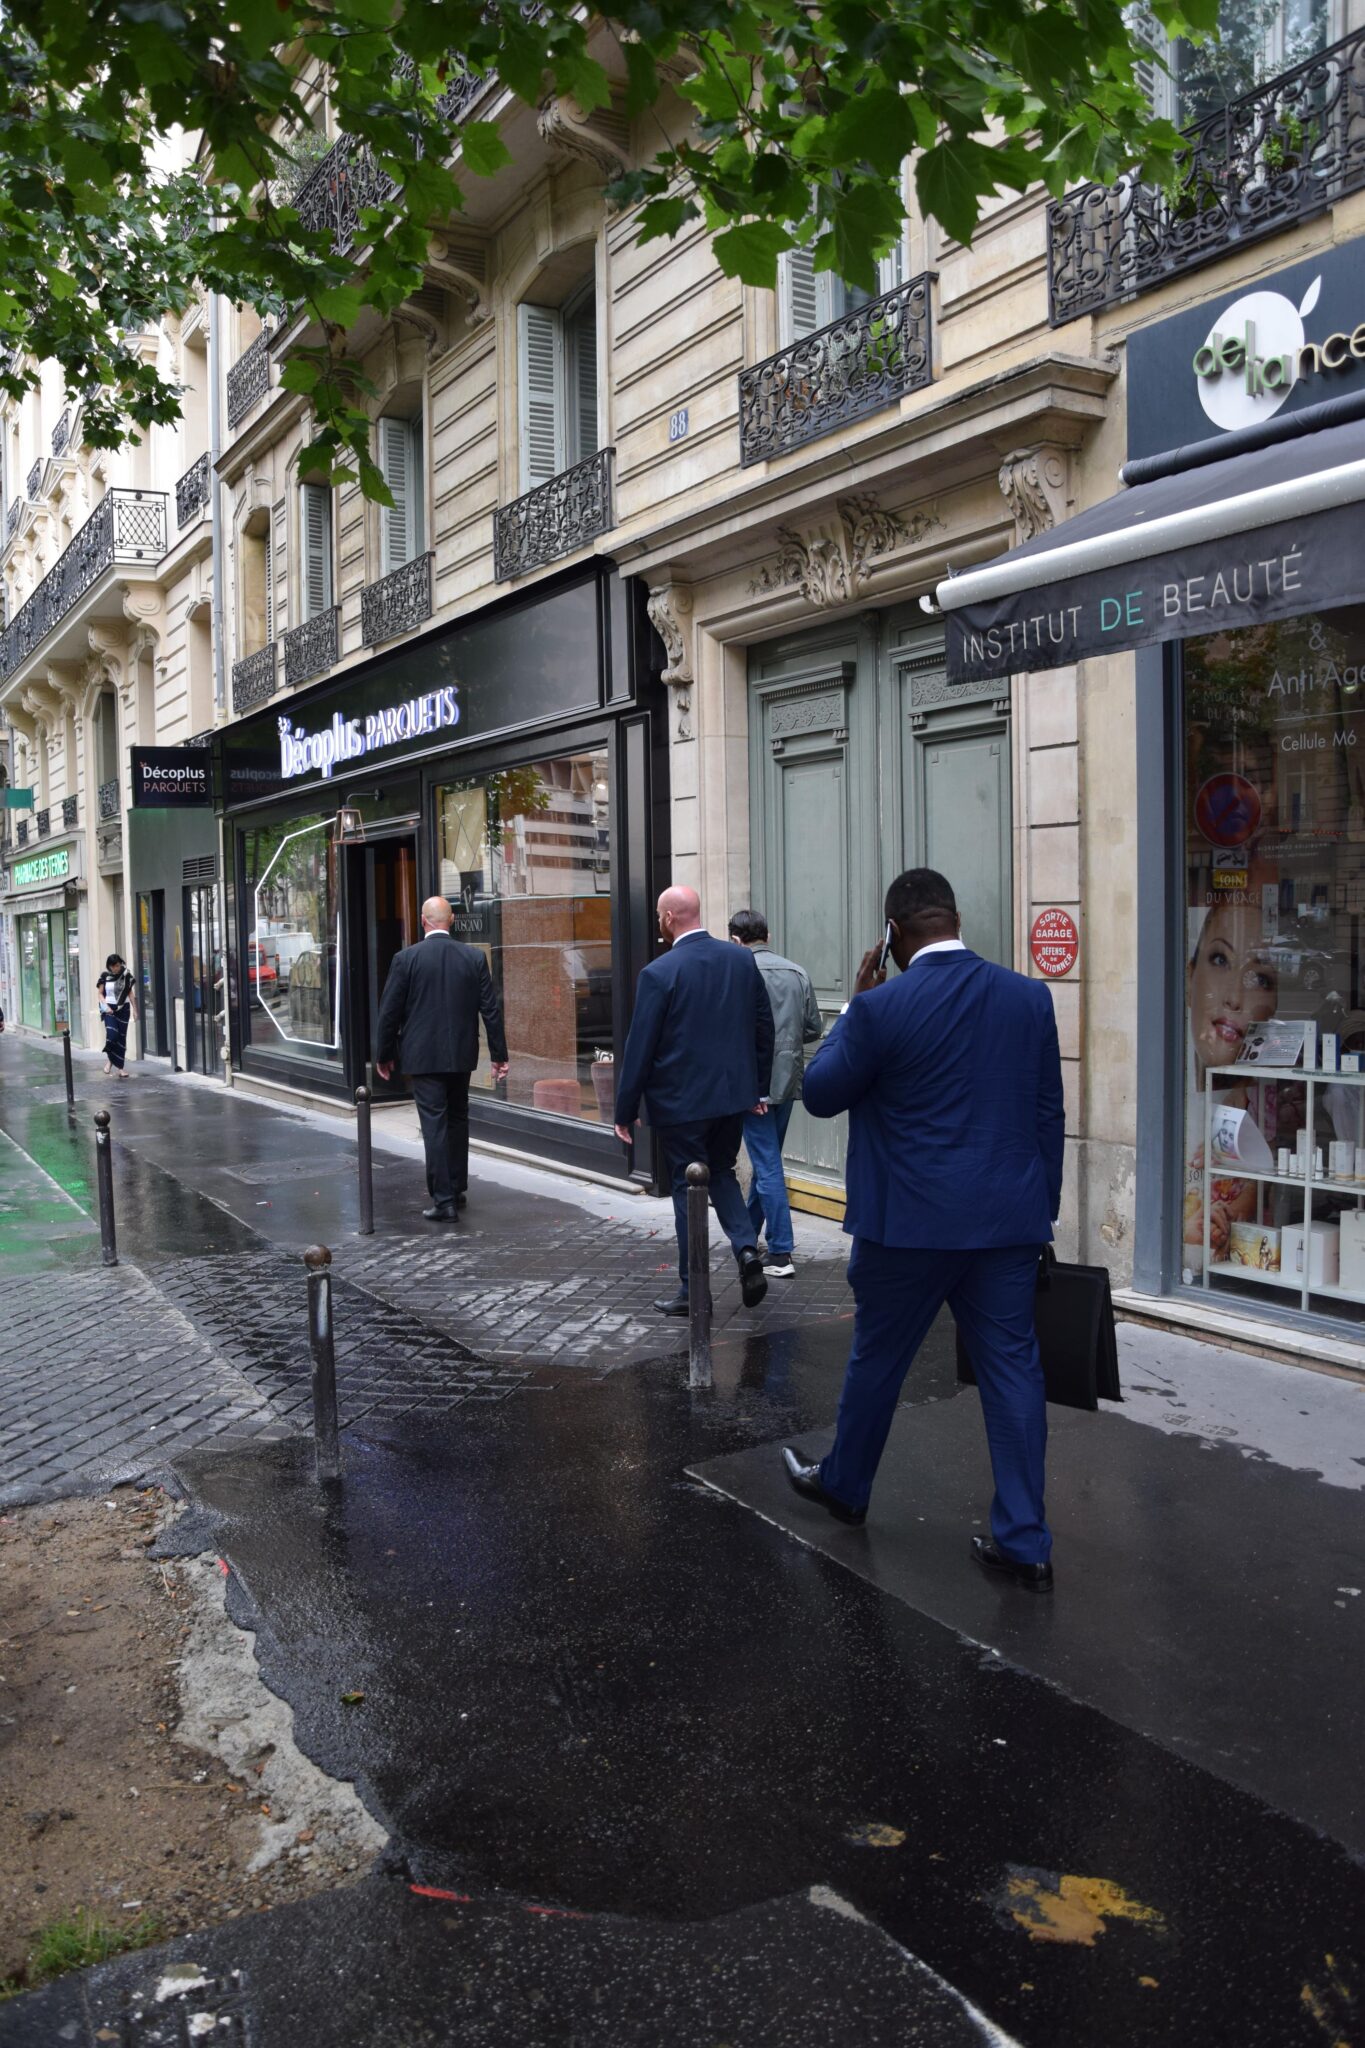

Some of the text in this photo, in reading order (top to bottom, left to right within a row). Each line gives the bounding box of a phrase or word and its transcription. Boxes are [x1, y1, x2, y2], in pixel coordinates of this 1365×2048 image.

[671, 411, 686, 439] 88
[963, 544, 1302, 663] INSTITUT DE BEAUTÉ
[1309, 623, 1327, 650] &
[1268, 666, 1313, 697] Anti
[280, 686, 460, 778] Décoplus PARQUETS
[1281, 730, 1357, 751] Cellule M6
[143, 766, 205, 781] Décoplus
[143, 782, 206, 792] PARQUETS
[14, 860, 39, 885] PHARMACIE
[39, 856, 48, 880] DES
[48, 850, 69, 878] TERNES
[1040, 912, 1069, 927] SORTIE
[1036, 929, 1072, 938] GARAGE
[1036, 953, 1073, 973] STATIONNER
